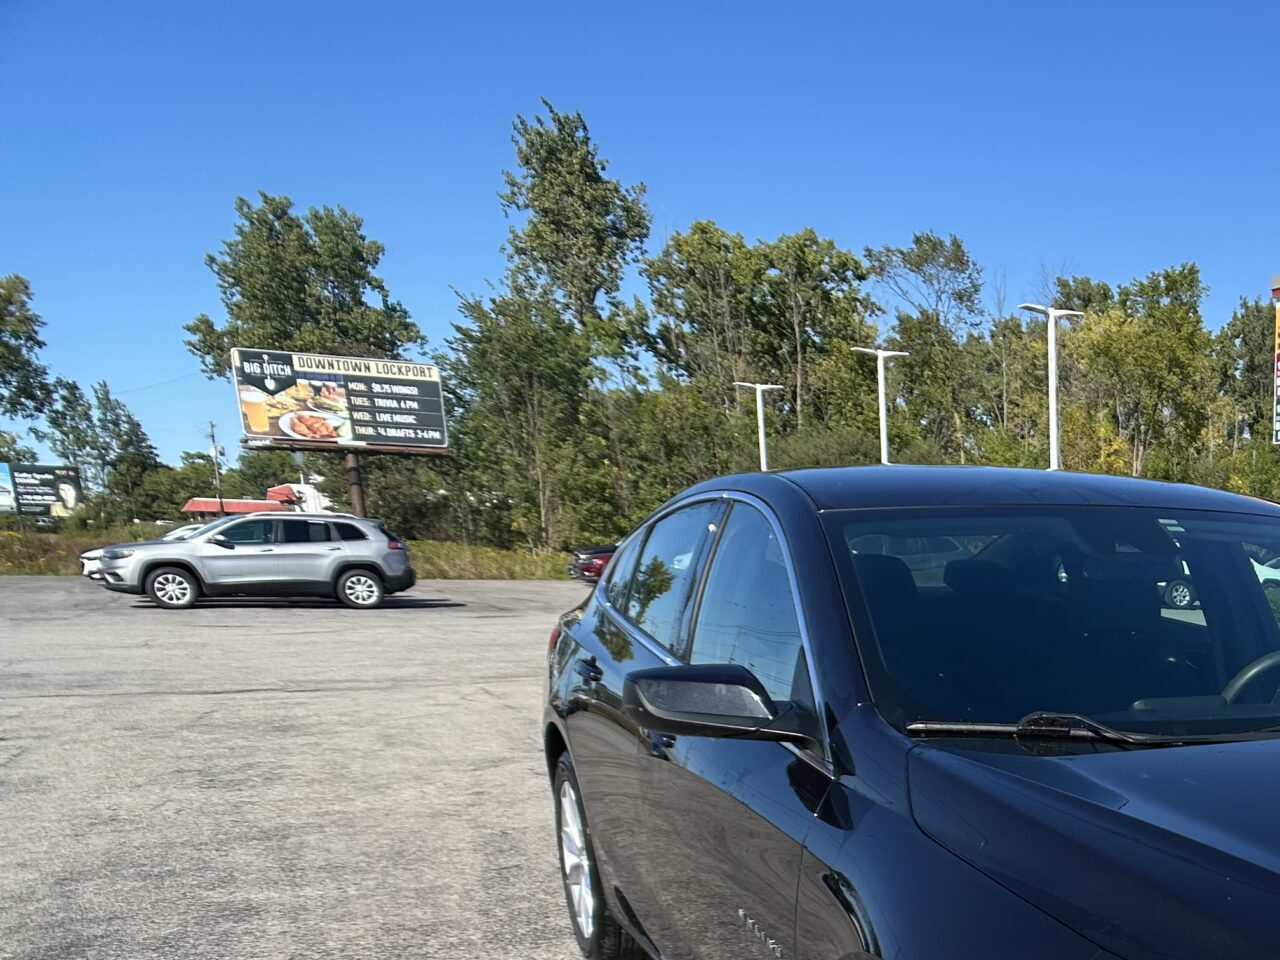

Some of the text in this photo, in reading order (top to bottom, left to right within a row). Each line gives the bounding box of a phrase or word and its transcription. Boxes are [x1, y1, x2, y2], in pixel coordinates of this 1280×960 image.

[243, 361, 260, 373] BIG
[263, 363, 292, 376] DITCH
[298, 357, 433, 379] DOWNTOWN LOCKPORT
[349, 396, 371, 406] TUES:
[374, 398, 399, 408] TRIVIA
[405, 400, 419, 409] PM
[351, 411, 417, 424] WED: LIVE MUSIC
[386, 428, 415, 438] DRAFTS
[428, 430, 441, 440] PM
